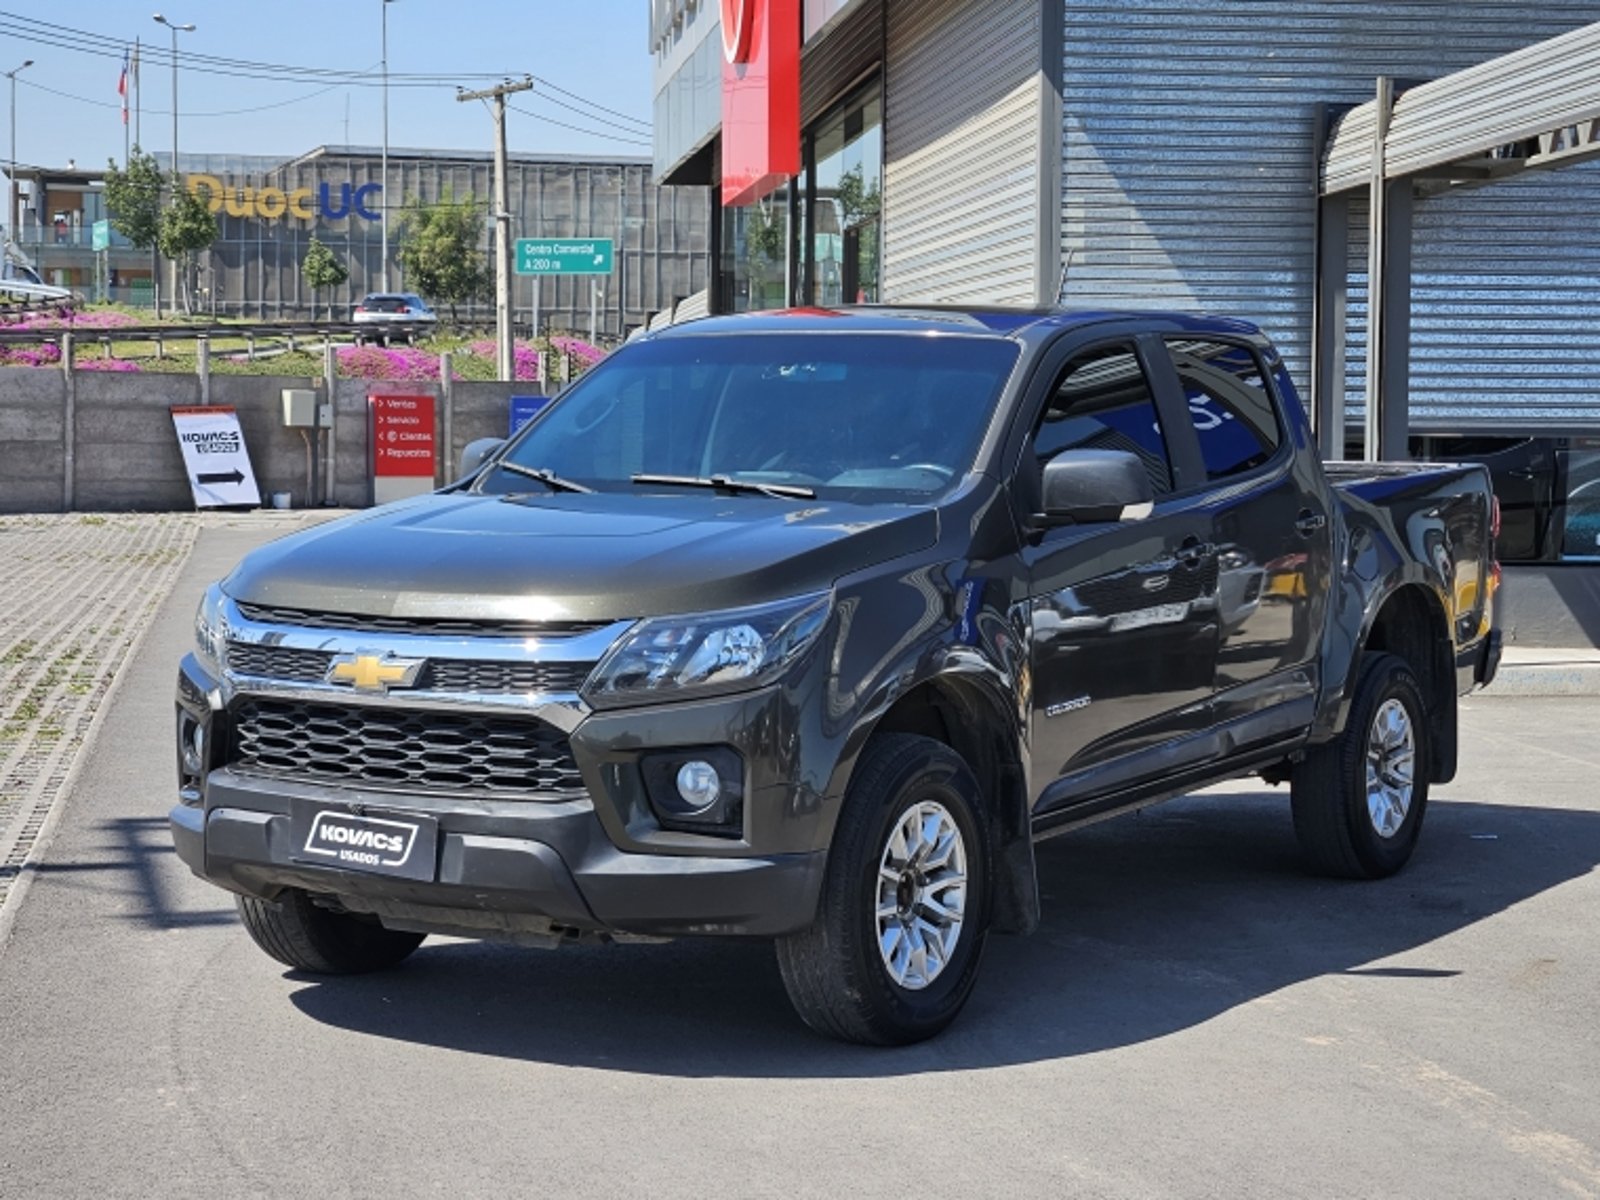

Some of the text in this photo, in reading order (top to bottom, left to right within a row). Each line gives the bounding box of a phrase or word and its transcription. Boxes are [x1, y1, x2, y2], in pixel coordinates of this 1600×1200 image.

[525, 243, 595, 255] Centro Comercial
[524, 259, 561, 270] A 200 m
[386, 399, 417, 409] Ventas
[386, 416, 420, 425] Servicio
[181, 430, 240, 443] KOVACS
[386, 447, 432, 458] Repuestos
[320, 824, 403, 852] KOVACS
[340, 850, 380, 865] USADOS
